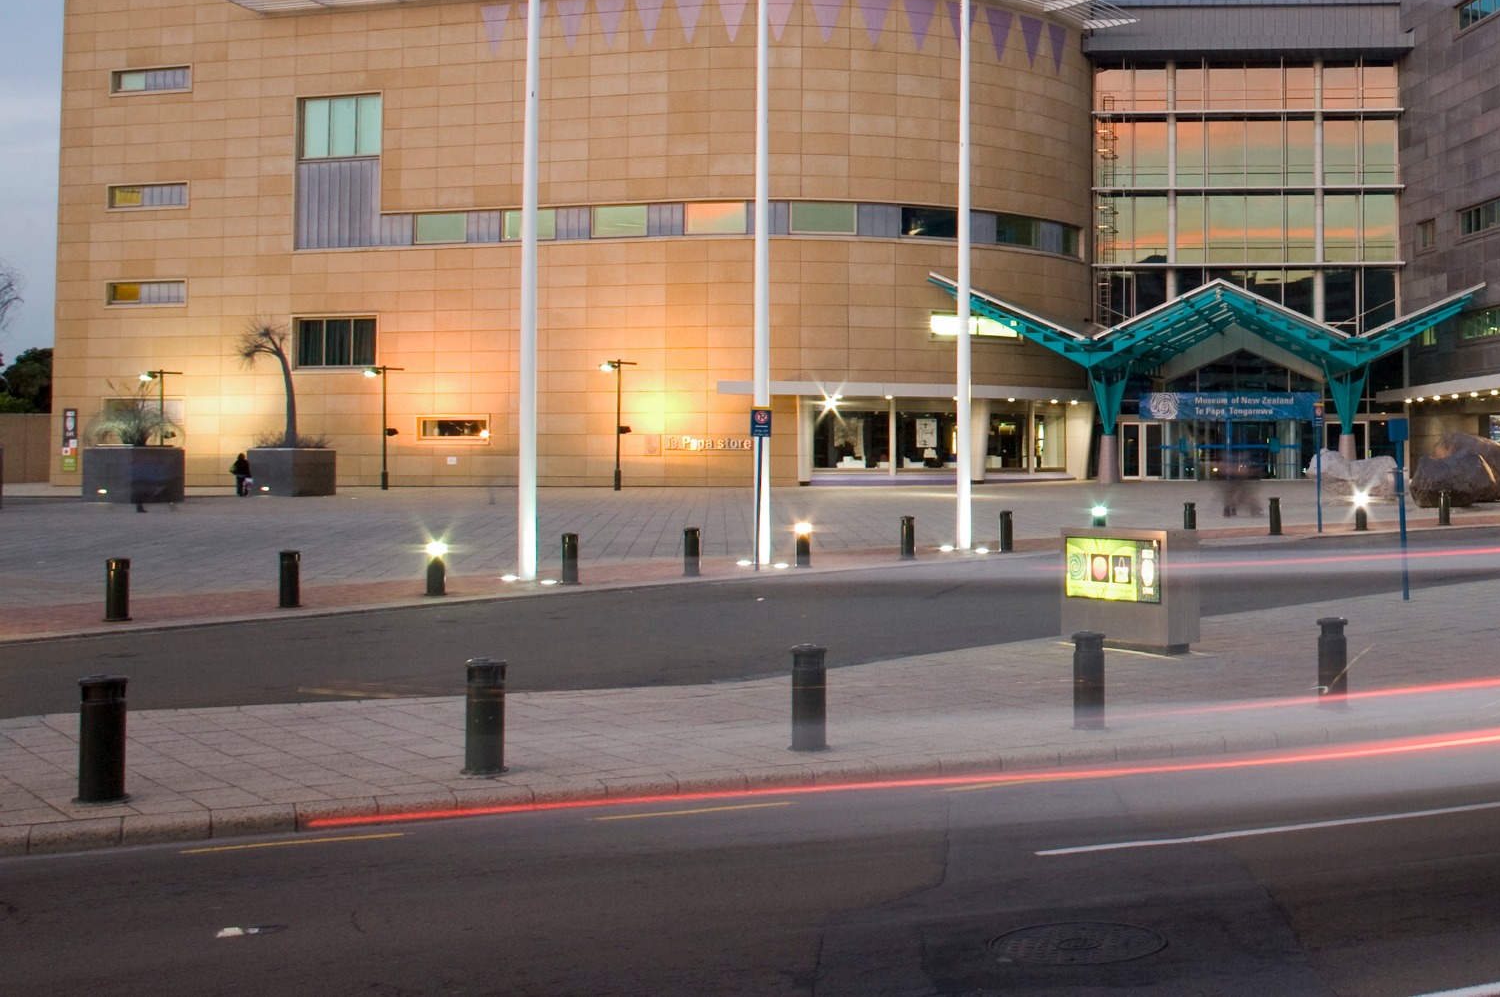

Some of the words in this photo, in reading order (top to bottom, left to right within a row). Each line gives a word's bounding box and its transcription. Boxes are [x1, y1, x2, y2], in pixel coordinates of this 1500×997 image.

[1194, 396, 1228, 404] Museum
[1231, 396, 1240, 404] of
[1240, 396, 1260, 404] New
[1262, 396, 1294, 404] Zealand
[1195, 407, 1204, 415] Te
[1205, 407, 1225, 417] Papa
[1229, 407, 1274, 416] Tongarewa
[682, 436, 713, 452] Papa
[717, 437, 752, 450] store
